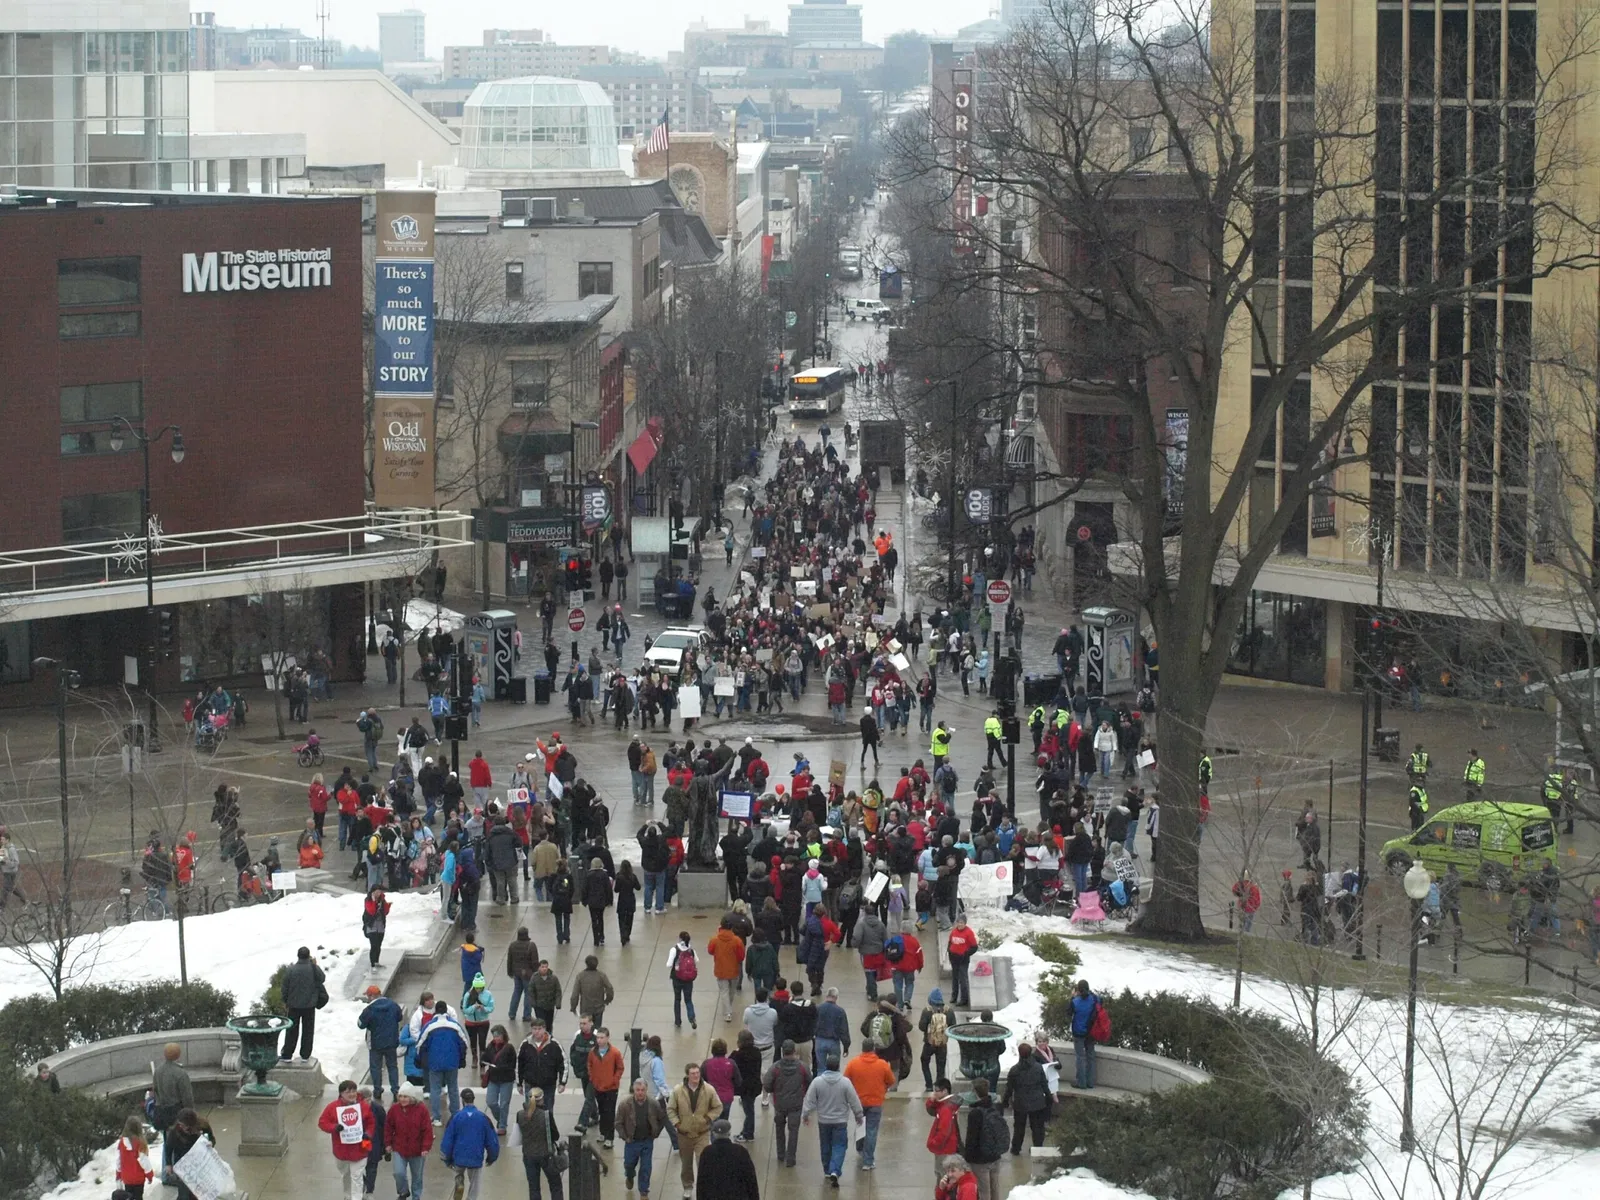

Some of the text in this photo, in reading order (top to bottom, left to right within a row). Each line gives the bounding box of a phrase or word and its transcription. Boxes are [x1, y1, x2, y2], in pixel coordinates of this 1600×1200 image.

[220, 247, 331, 264] The State Historical
[182, 251, 331, 293] Museum
[383, 266, 427, 279] There's
[397, 285, 412, 294] so
[387, 296, 422, 309] much
[382, 315, 427, 332] MORE
[398, 336, 411, 345] to
[393, 351, 416, 360] our
[380, 366, 429, 382] STORY
[388, 421, 419, 437] Odd
[583, 494, 592, 520] BLOCK
[592, 489, 605, 519] 100
[969, 490, 982, 519] 100
[982, 495, 990, 520] BLOCK
[342, 1111, 358, 1122] STOP
